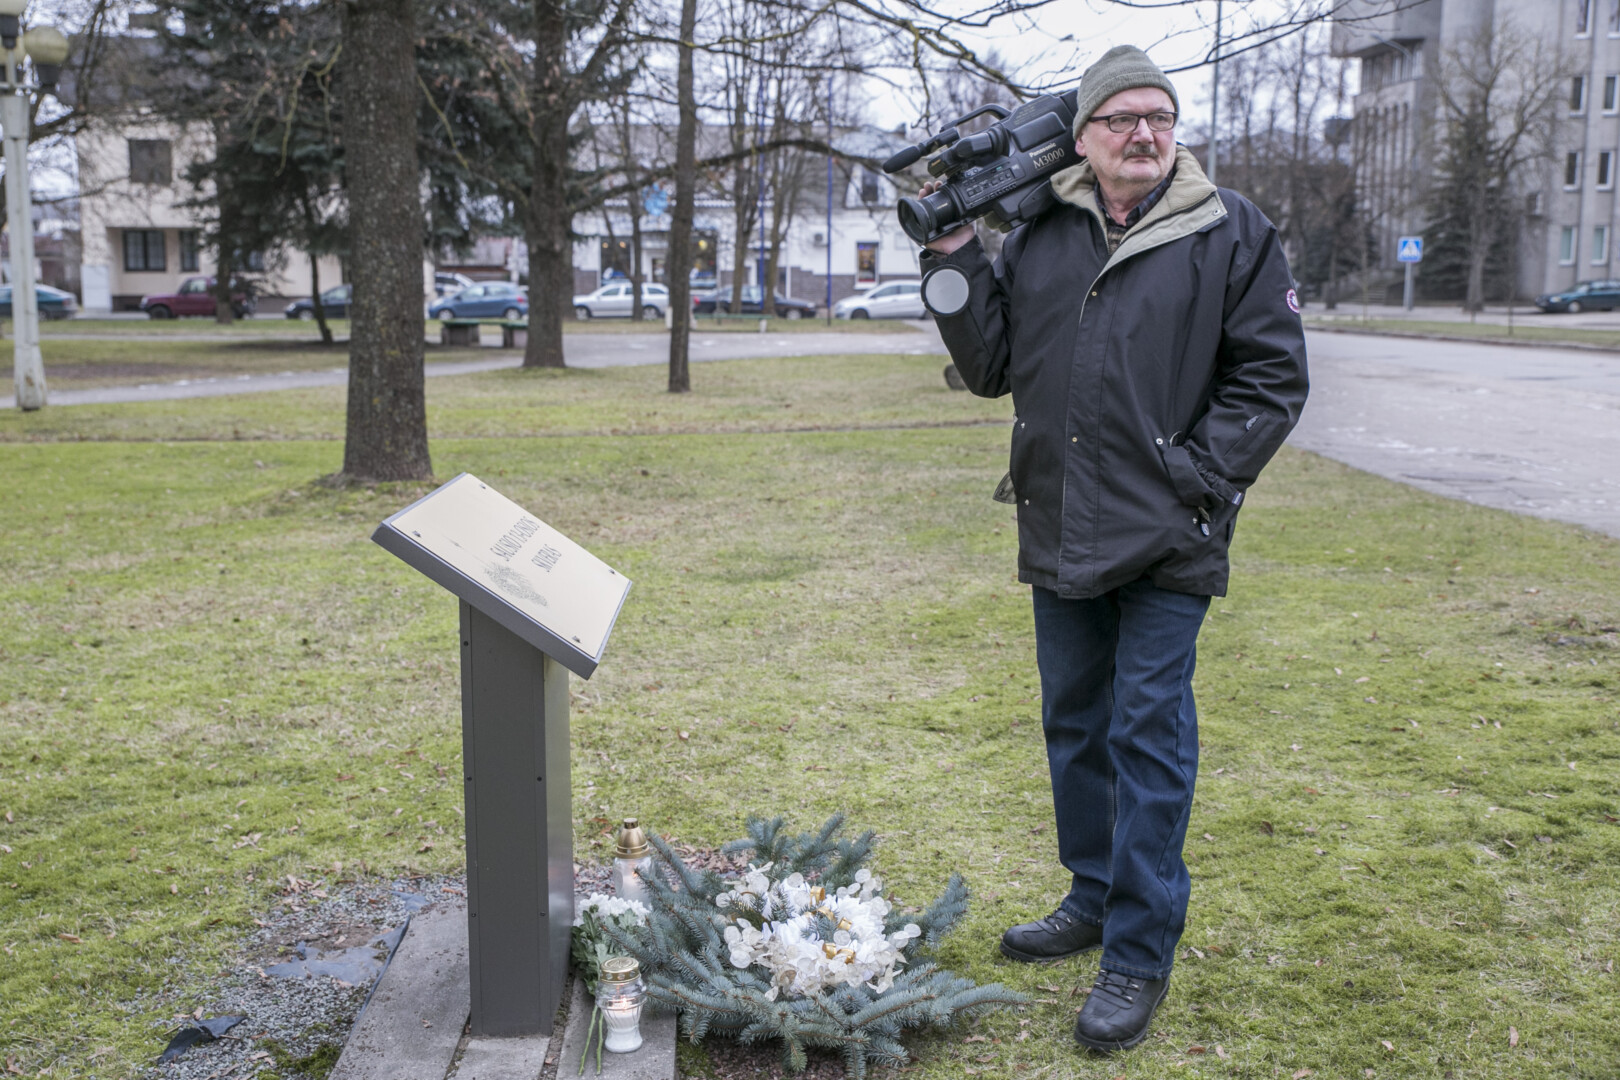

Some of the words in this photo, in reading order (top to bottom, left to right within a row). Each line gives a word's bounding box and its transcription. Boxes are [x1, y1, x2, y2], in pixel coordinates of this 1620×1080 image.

[1028, 142, 1057, 158] Panasonic
[1033, 147, 1065, 169] M3000
[490, 534, 522, 562] SAUSIO
[508, 515, 540, 543] 13-OSIOS
[531, 543, 562, 572] SKVERAS
